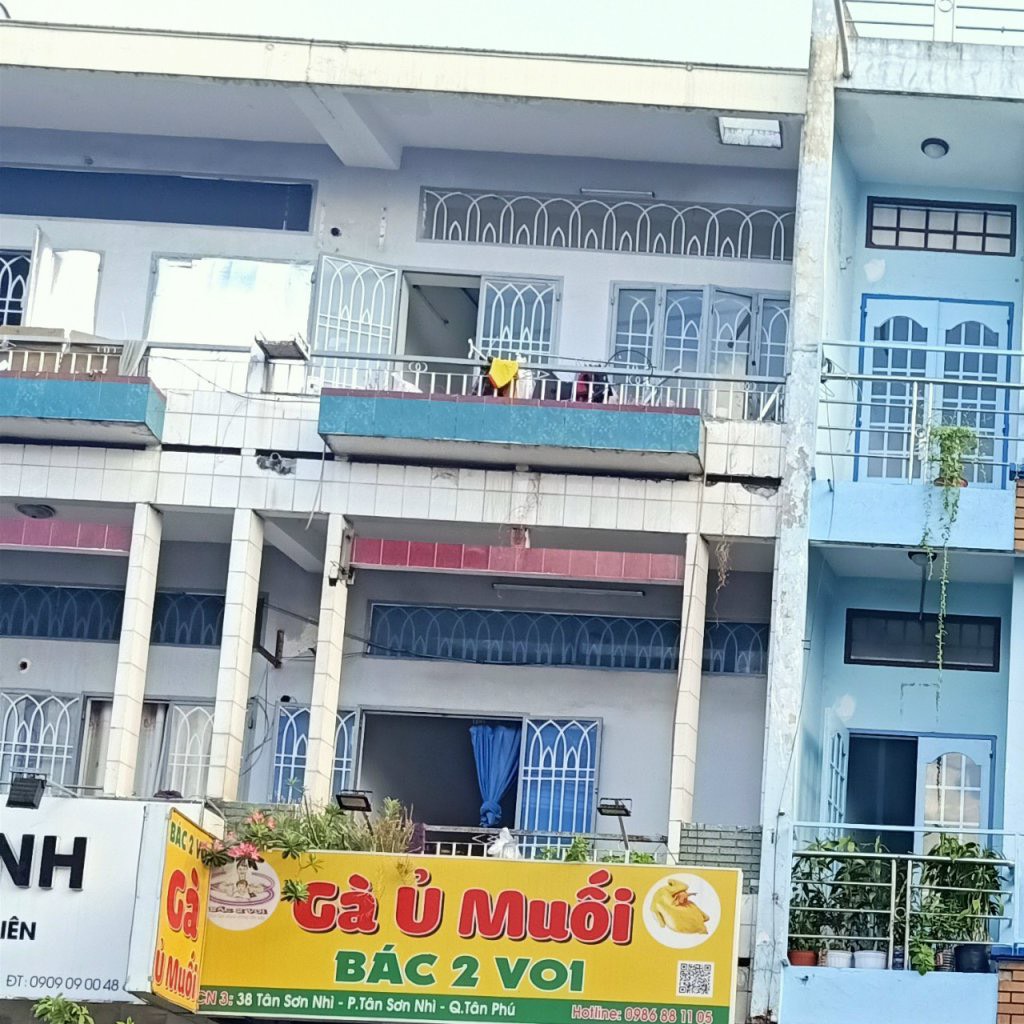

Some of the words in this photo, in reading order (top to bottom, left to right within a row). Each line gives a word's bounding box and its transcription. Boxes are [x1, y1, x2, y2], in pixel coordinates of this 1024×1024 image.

[166, 867, 199, 941] Gà
[293, 872, 379, 934] Gà
[395, 867, 444, 938] Ủ
[457, 868, 636, 945] Muối
[166, 950, 198, 1001] Muối
[333, 943, 439, 987] BÁC
[450, 953, 480, 990] 2
[236, 991, 253, 1007] 38
[257, 992, 281, 1008] Tân
[284, 993, 308, 1009] Sơn
[317, 994, 334, 1009] Nhì
[347, 996, 383, 1011] P.Tân
[386, 997, 410, 1012] Sơn
[414, 998, 436, 1013] Nhì
[449, 1000, 488, 1016] Q.Tân
[491, 1002, 515, 1017] Phú
[571, 1004, 621, 1022] Hotline:
[624, 1007, 657, 1023] 0986
[659, 1008, 677, 1024] 88
[681, 1009, 694, 1024] 11
[696, 1010, 713, 1024] 05
